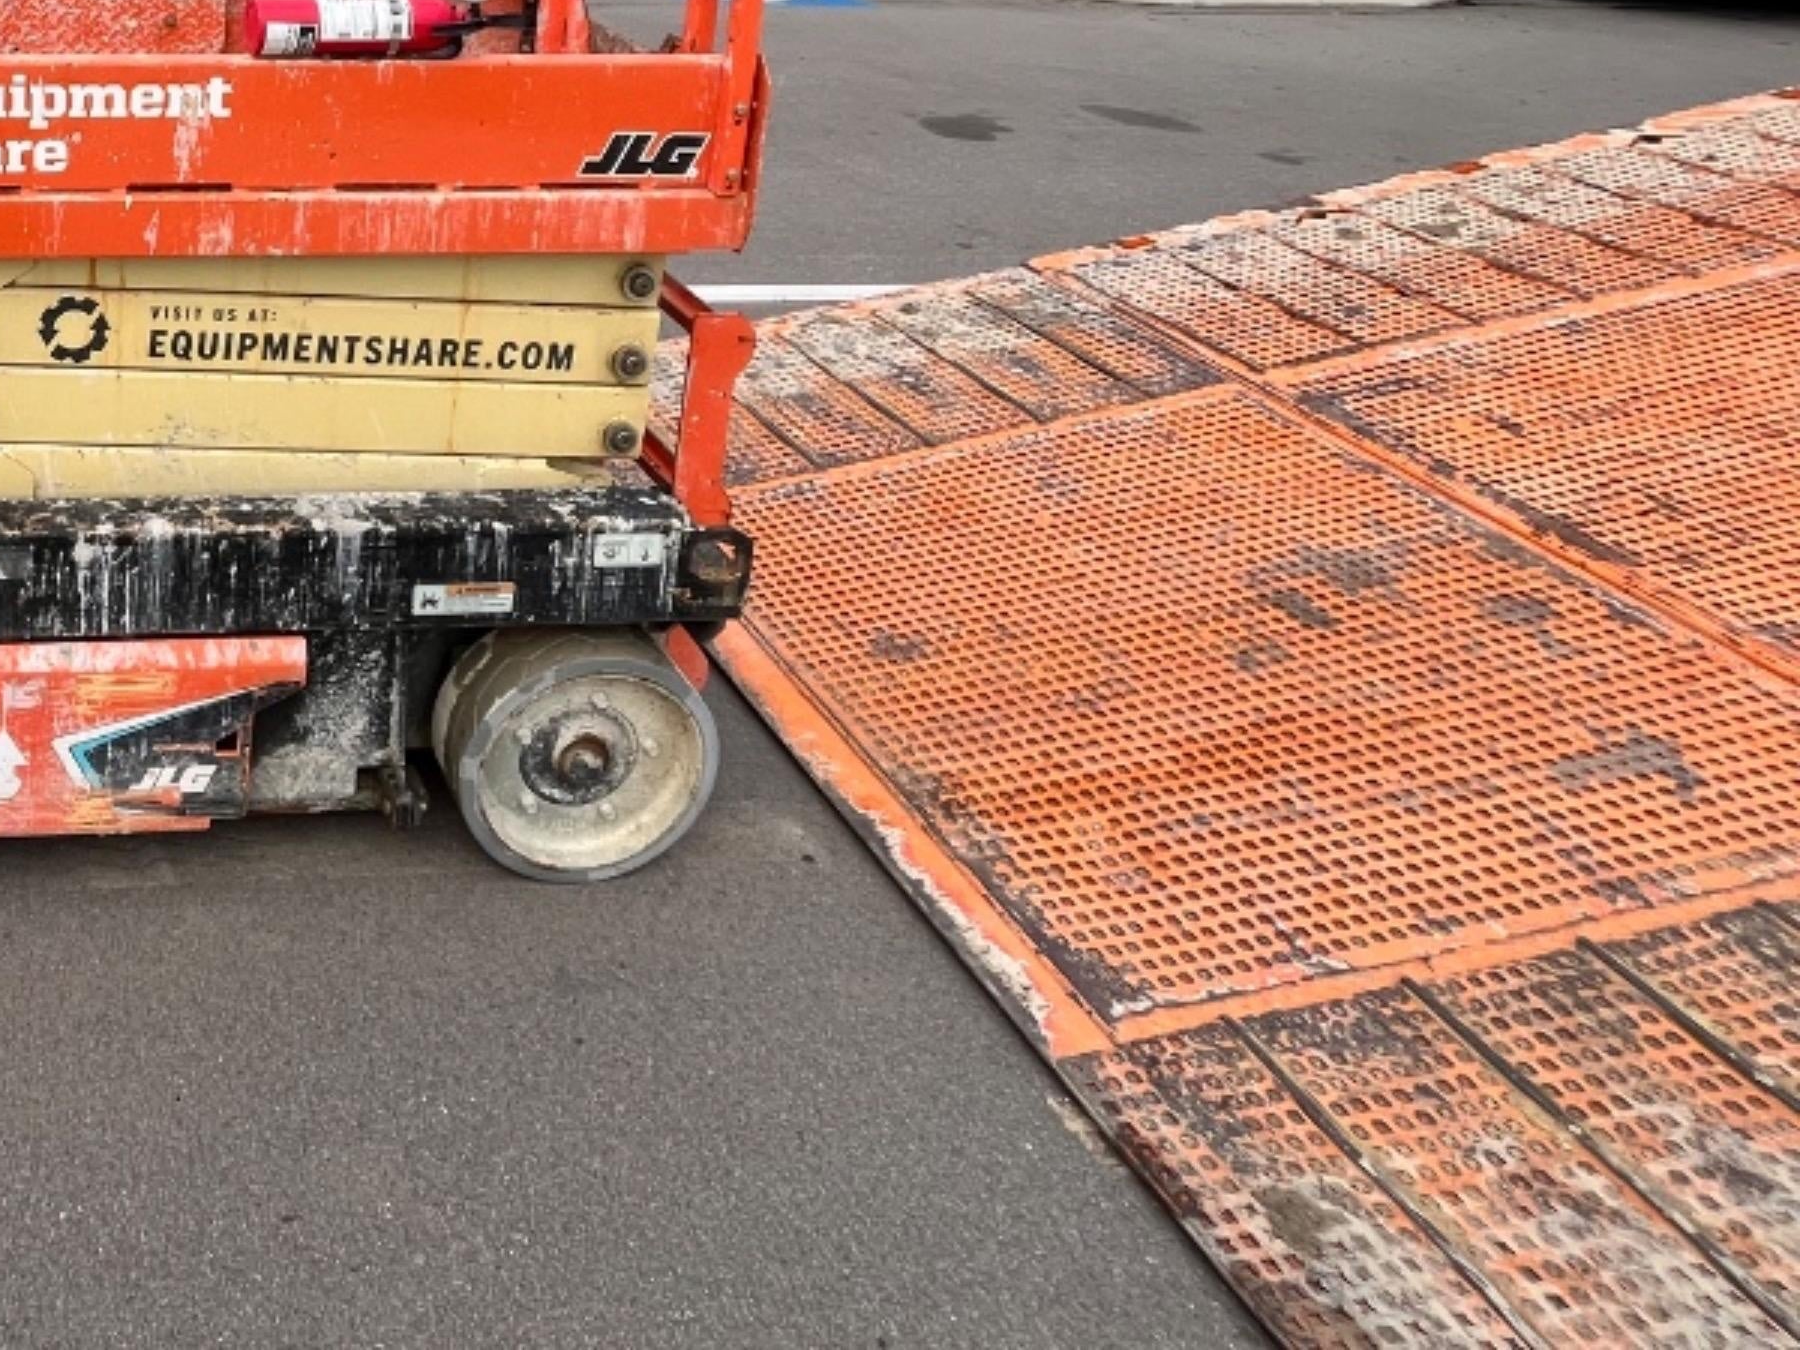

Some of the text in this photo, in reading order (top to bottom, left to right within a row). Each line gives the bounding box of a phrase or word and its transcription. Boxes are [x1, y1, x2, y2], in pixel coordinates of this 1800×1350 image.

[578, 132, 711, 176] JLG
[150, 306, 277, 322] VISIT US AT:
[148, 329, 575, 372] EQUIPMENTSHARE.COM
[126, 764, 217, 793] JLG
